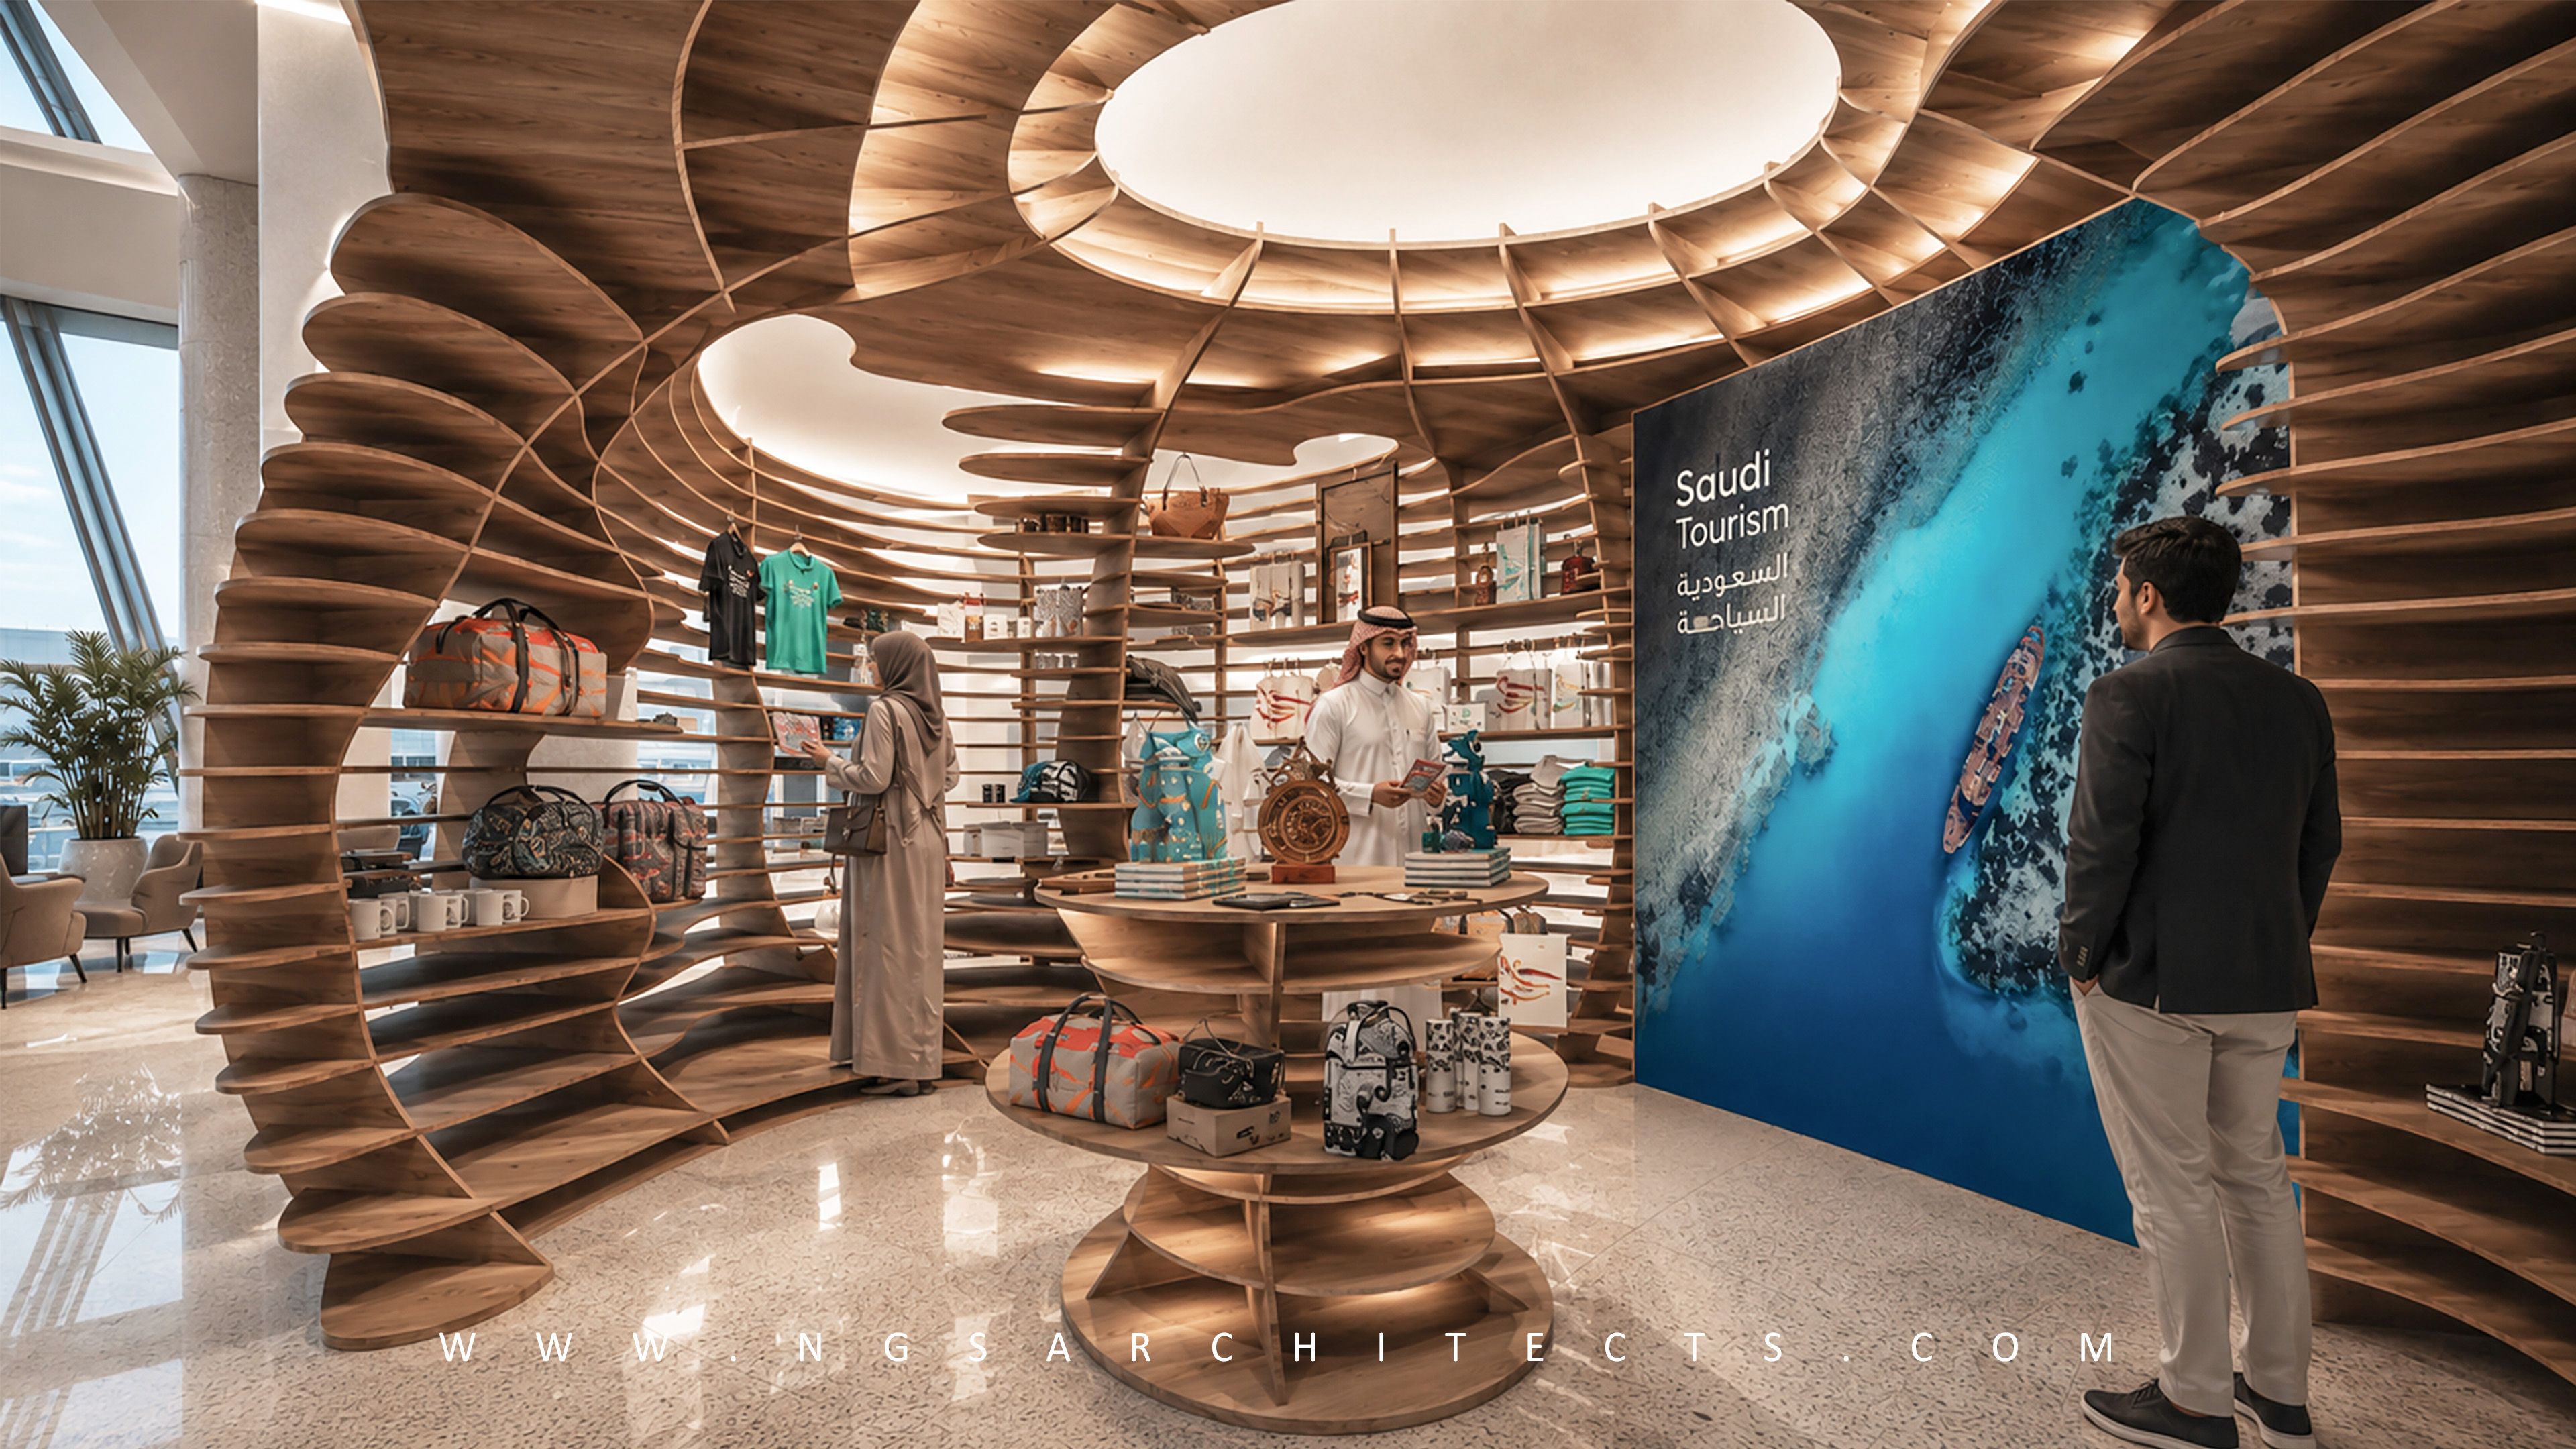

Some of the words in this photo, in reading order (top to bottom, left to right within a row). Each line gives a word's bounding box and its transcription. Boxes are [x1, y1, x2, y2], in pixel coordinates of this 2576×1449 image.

[1676, 448, 1770, 506] Saudi
[1676, 503, 1789, 549] Tourism
[1677, 552, 1788, 601] السعودية
